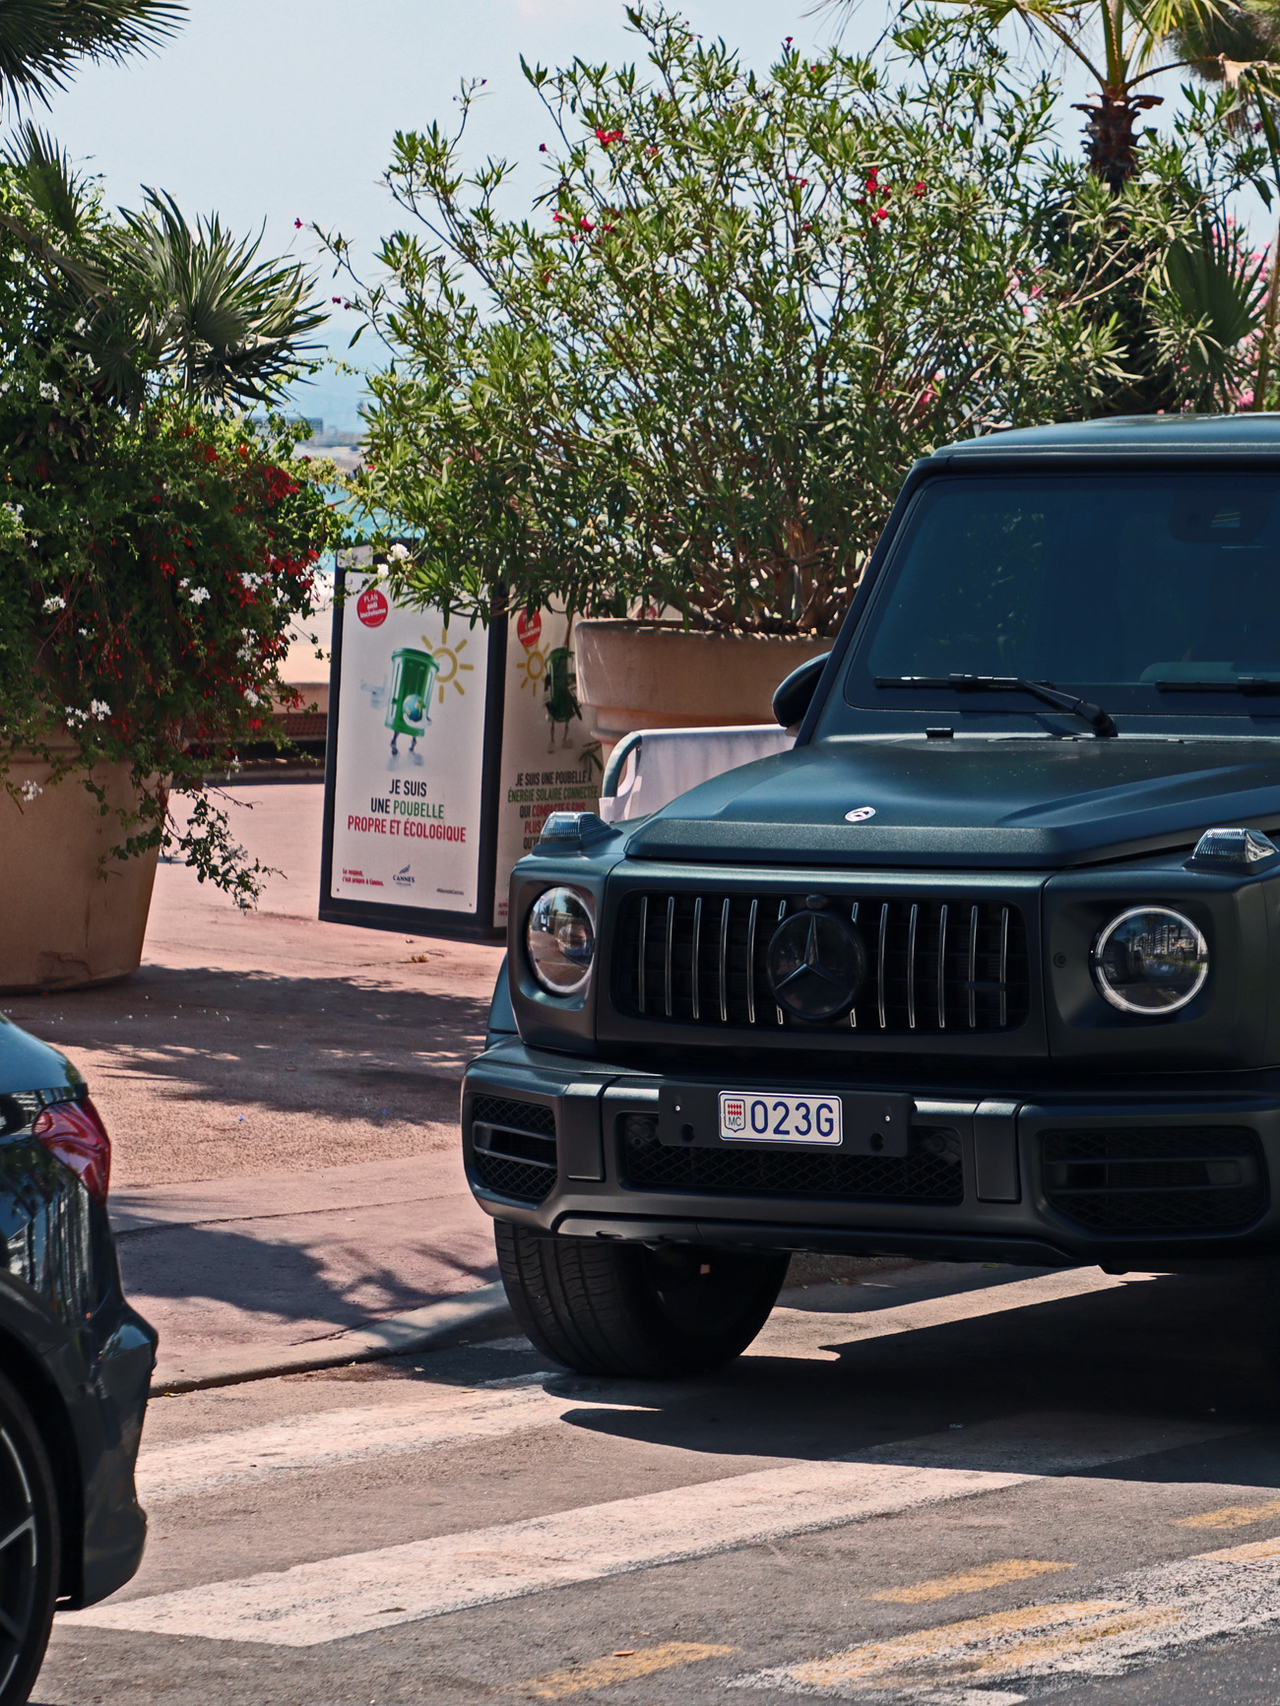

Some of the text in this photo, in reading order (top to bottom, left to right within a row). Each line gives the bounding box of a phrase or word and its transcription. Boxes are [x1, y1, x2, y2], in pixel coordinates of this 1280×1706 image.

[364, 594, 378, 602] PLAN
[516, 773, 524, 786] JE
[525, 772, 540, 786] SUIS
[541, 772, 554, 785] UNE
[555, 770, 587, 784] POUBELLE
[389, 779, 427, 797] JE SUIS
[508, 785, 598, 802] ÉNERGIE SOLAIRE CONNECTÉE
[371, 797, 444, 819] UNE POUBELLE
[520, 805, 531, 818] QUI
[347, 815, 467, 843] PROPRE ET ÉCOLOGIQUE
[524, 821, 540, 834] PLUS
[392, 874, 416, 883] CANNES
[728, 1117, 741, 1126] MC
[751, 1100, 834, 1137] 023G
